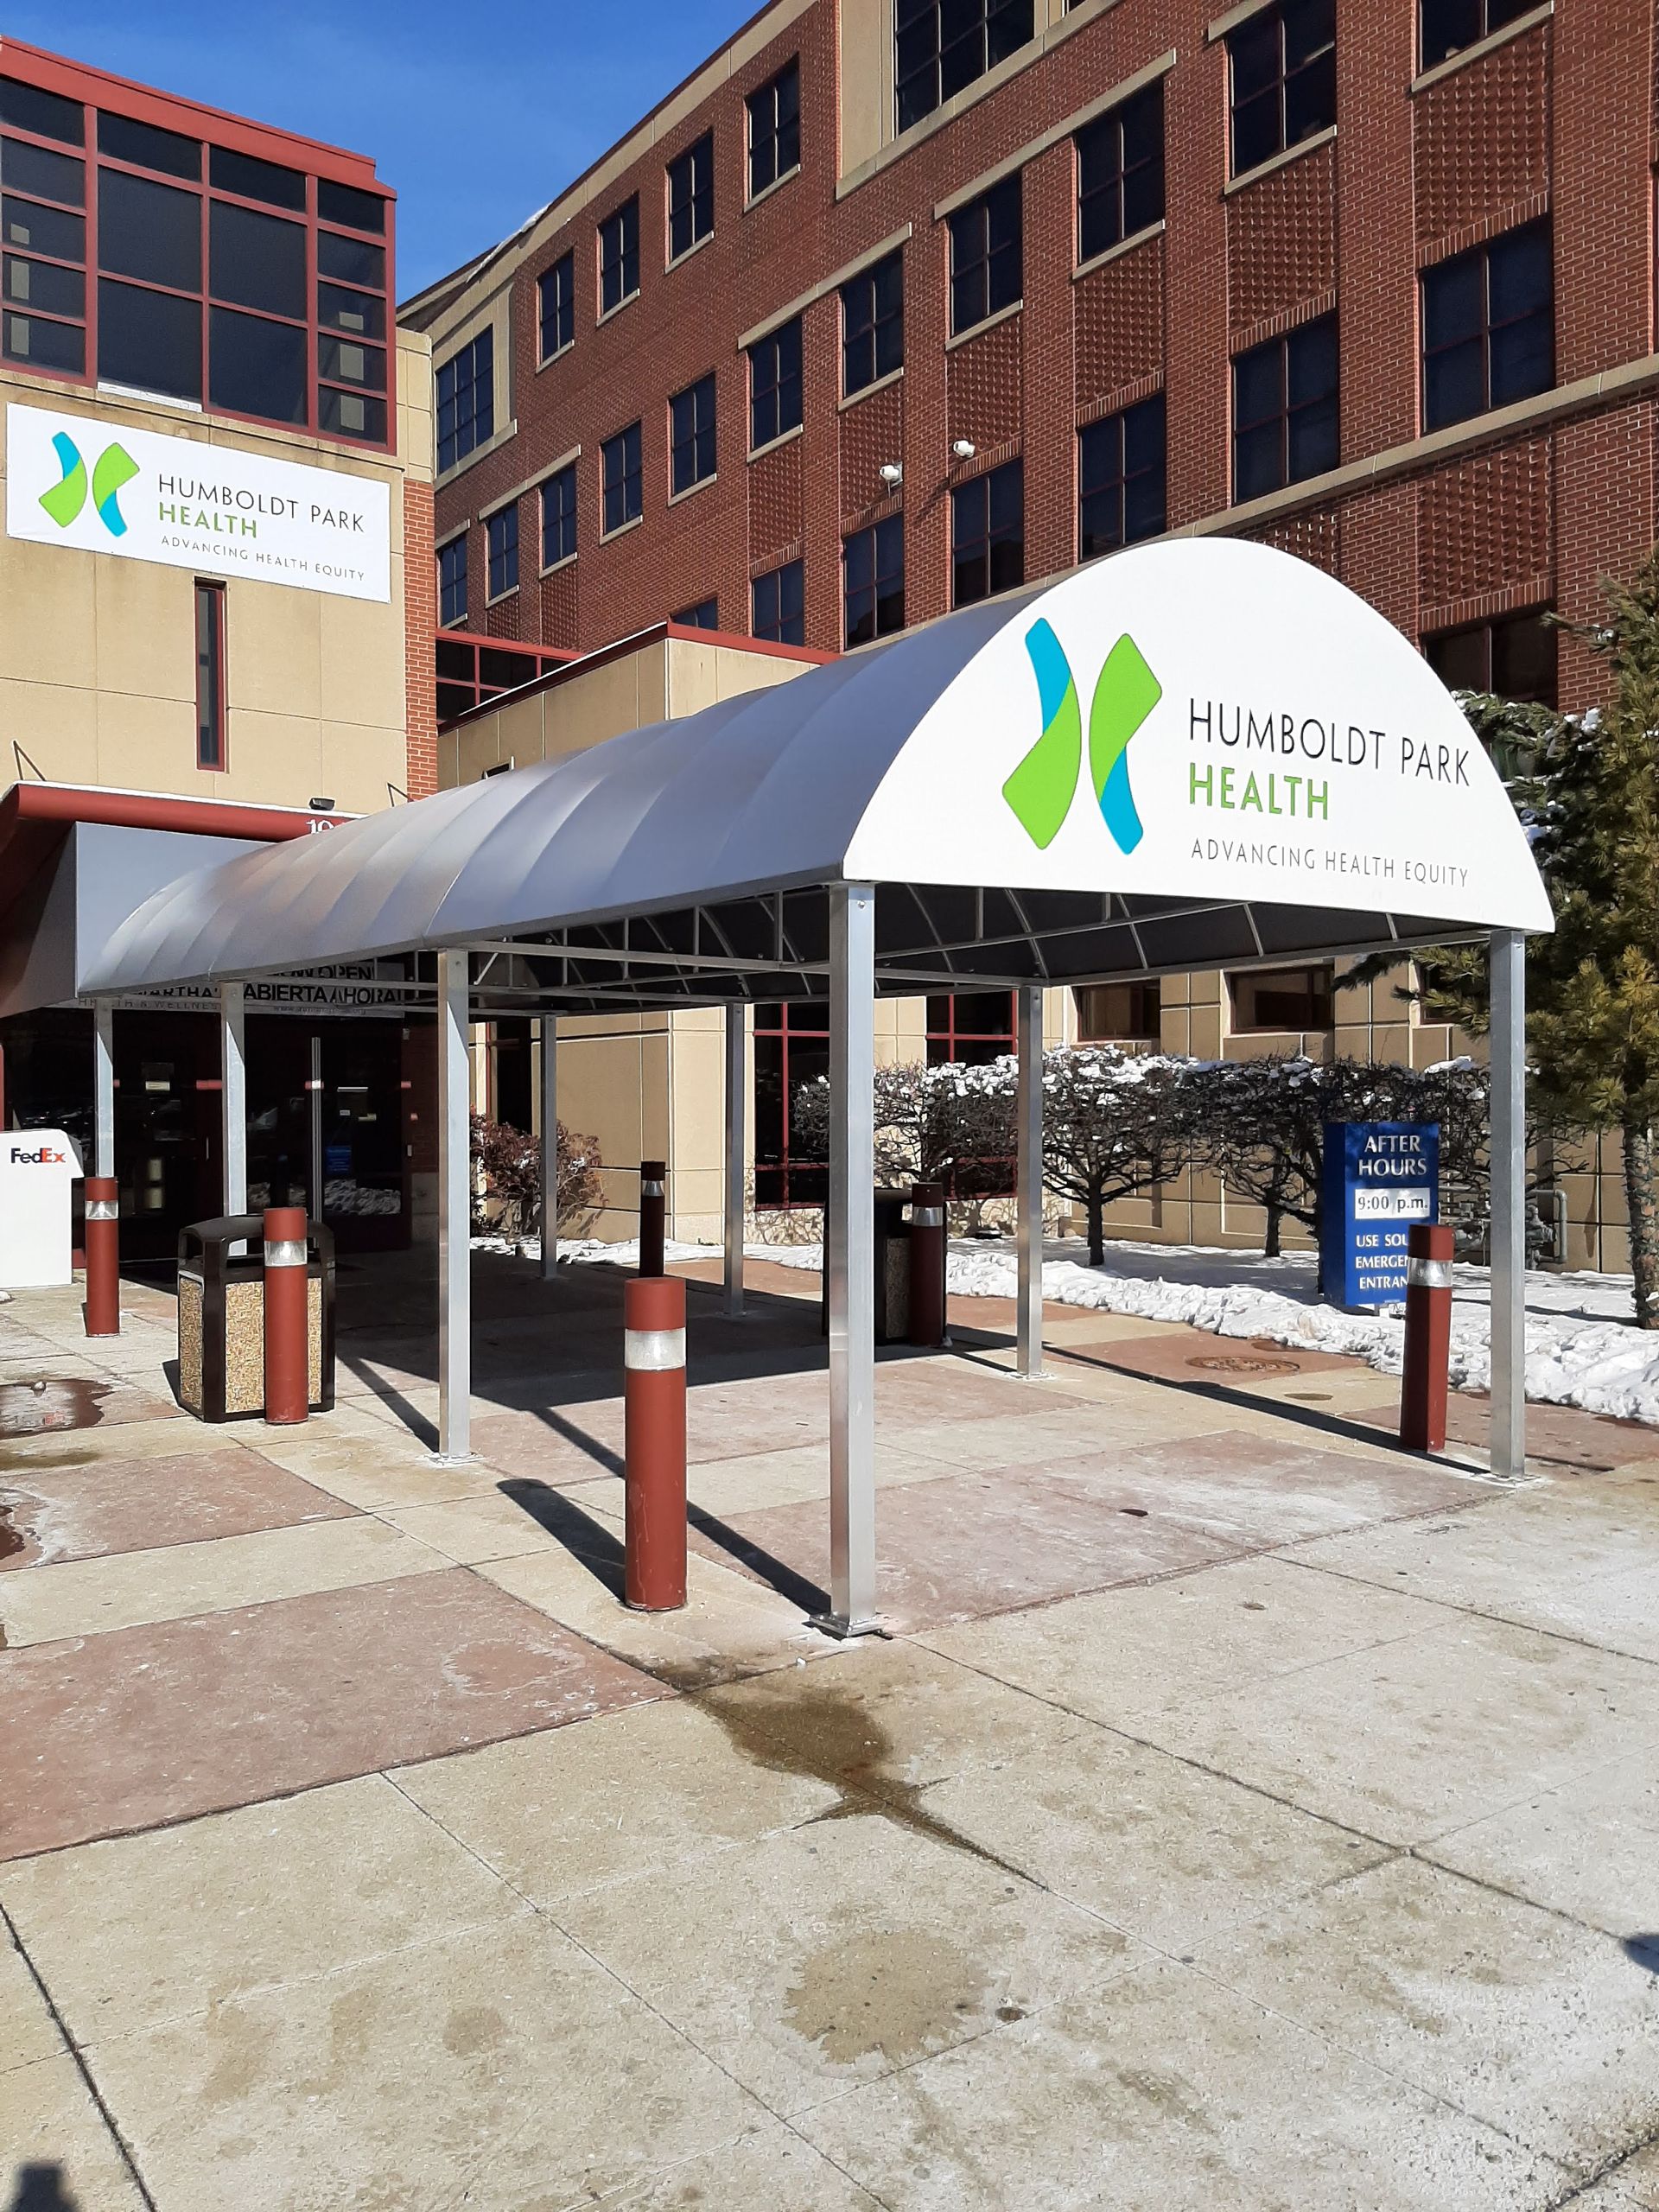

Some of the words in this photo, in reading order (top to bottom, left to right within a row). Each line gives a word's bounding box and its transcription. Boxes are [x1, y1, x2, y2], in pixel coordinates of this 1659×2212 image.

[159, 474, 299, 519] HUMBOLDT
[310, 505, 364, 532] PARK
[159, 502, 257, 538] HEALTH
[162, 535, 249, 561] ADVANCING
[256, 552, 308, 571] HEALTH
[315, 563, 365, 582] EQUITY
[1190, 698, 1386, 769] HUMBOLDT
[1402, 737, 1470, 786] PARK
[1189, 762, 1328, 820] HEALTH
[1191, 837, 1315, 869] ADVANCING
[1325, 850, 1395, 878] HEALTH
[1404, 861, 1468, 887] EQUITY
[243, 983, 327, 1003] ABIERTA
[10, 1147, 67, 1164] FedEx
[1364, 1135, 1421, 1153] AFTER
[1358, 1159, 1427, 1176] HOURS
[1357, 1196, 1389, 1210] 9:00
[1397, 1198, 1427, 1212] p.m.
[1356, 1234, 1379, 1247] USE
